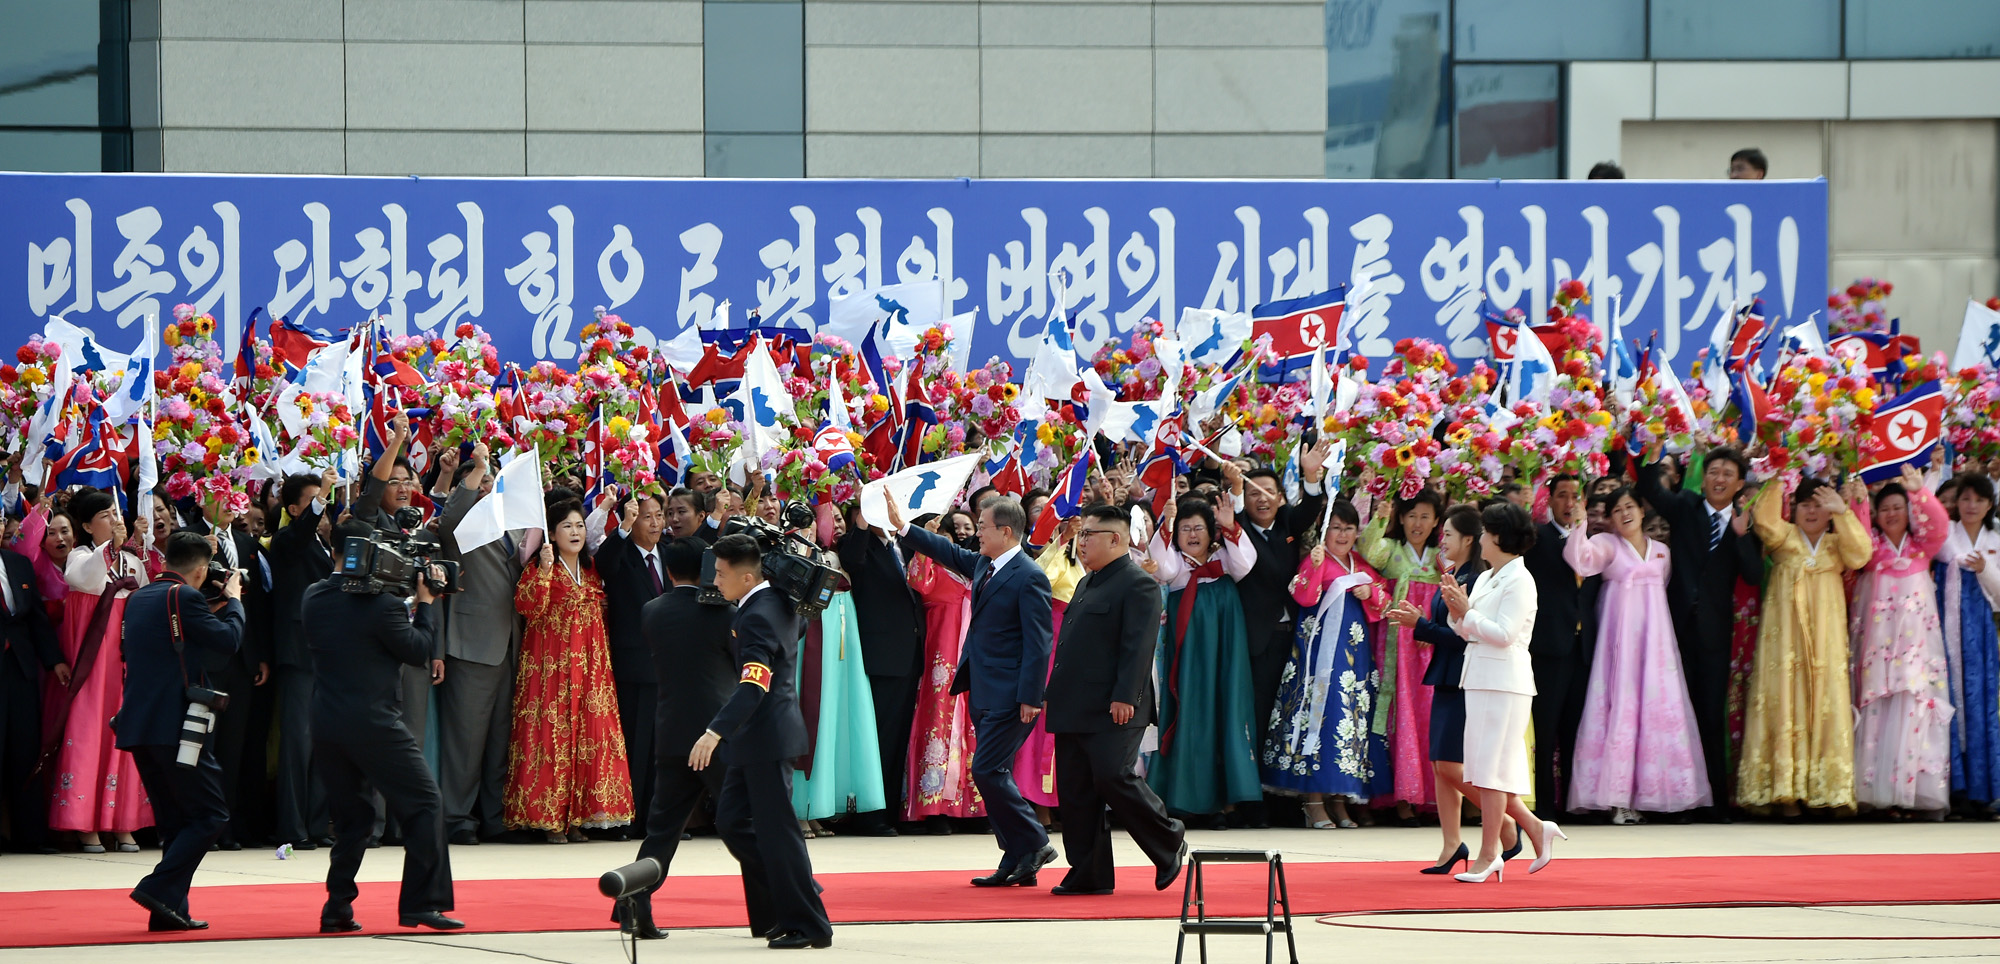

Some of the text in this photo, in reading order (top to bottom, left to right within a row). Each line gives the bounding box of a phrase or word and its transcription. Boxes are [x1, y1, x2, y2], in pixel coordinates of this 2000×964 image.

[28, 197, 241, 364] 민족의
[267, 200, 485, 356] 단합된
[504, 204, 723, 360] 힘으로
[986, 207, 1176, 364] 번영의
[1201, 206, 1406, 358] 시대를
[1420, 204, 1800, 363] 열어나가자!
